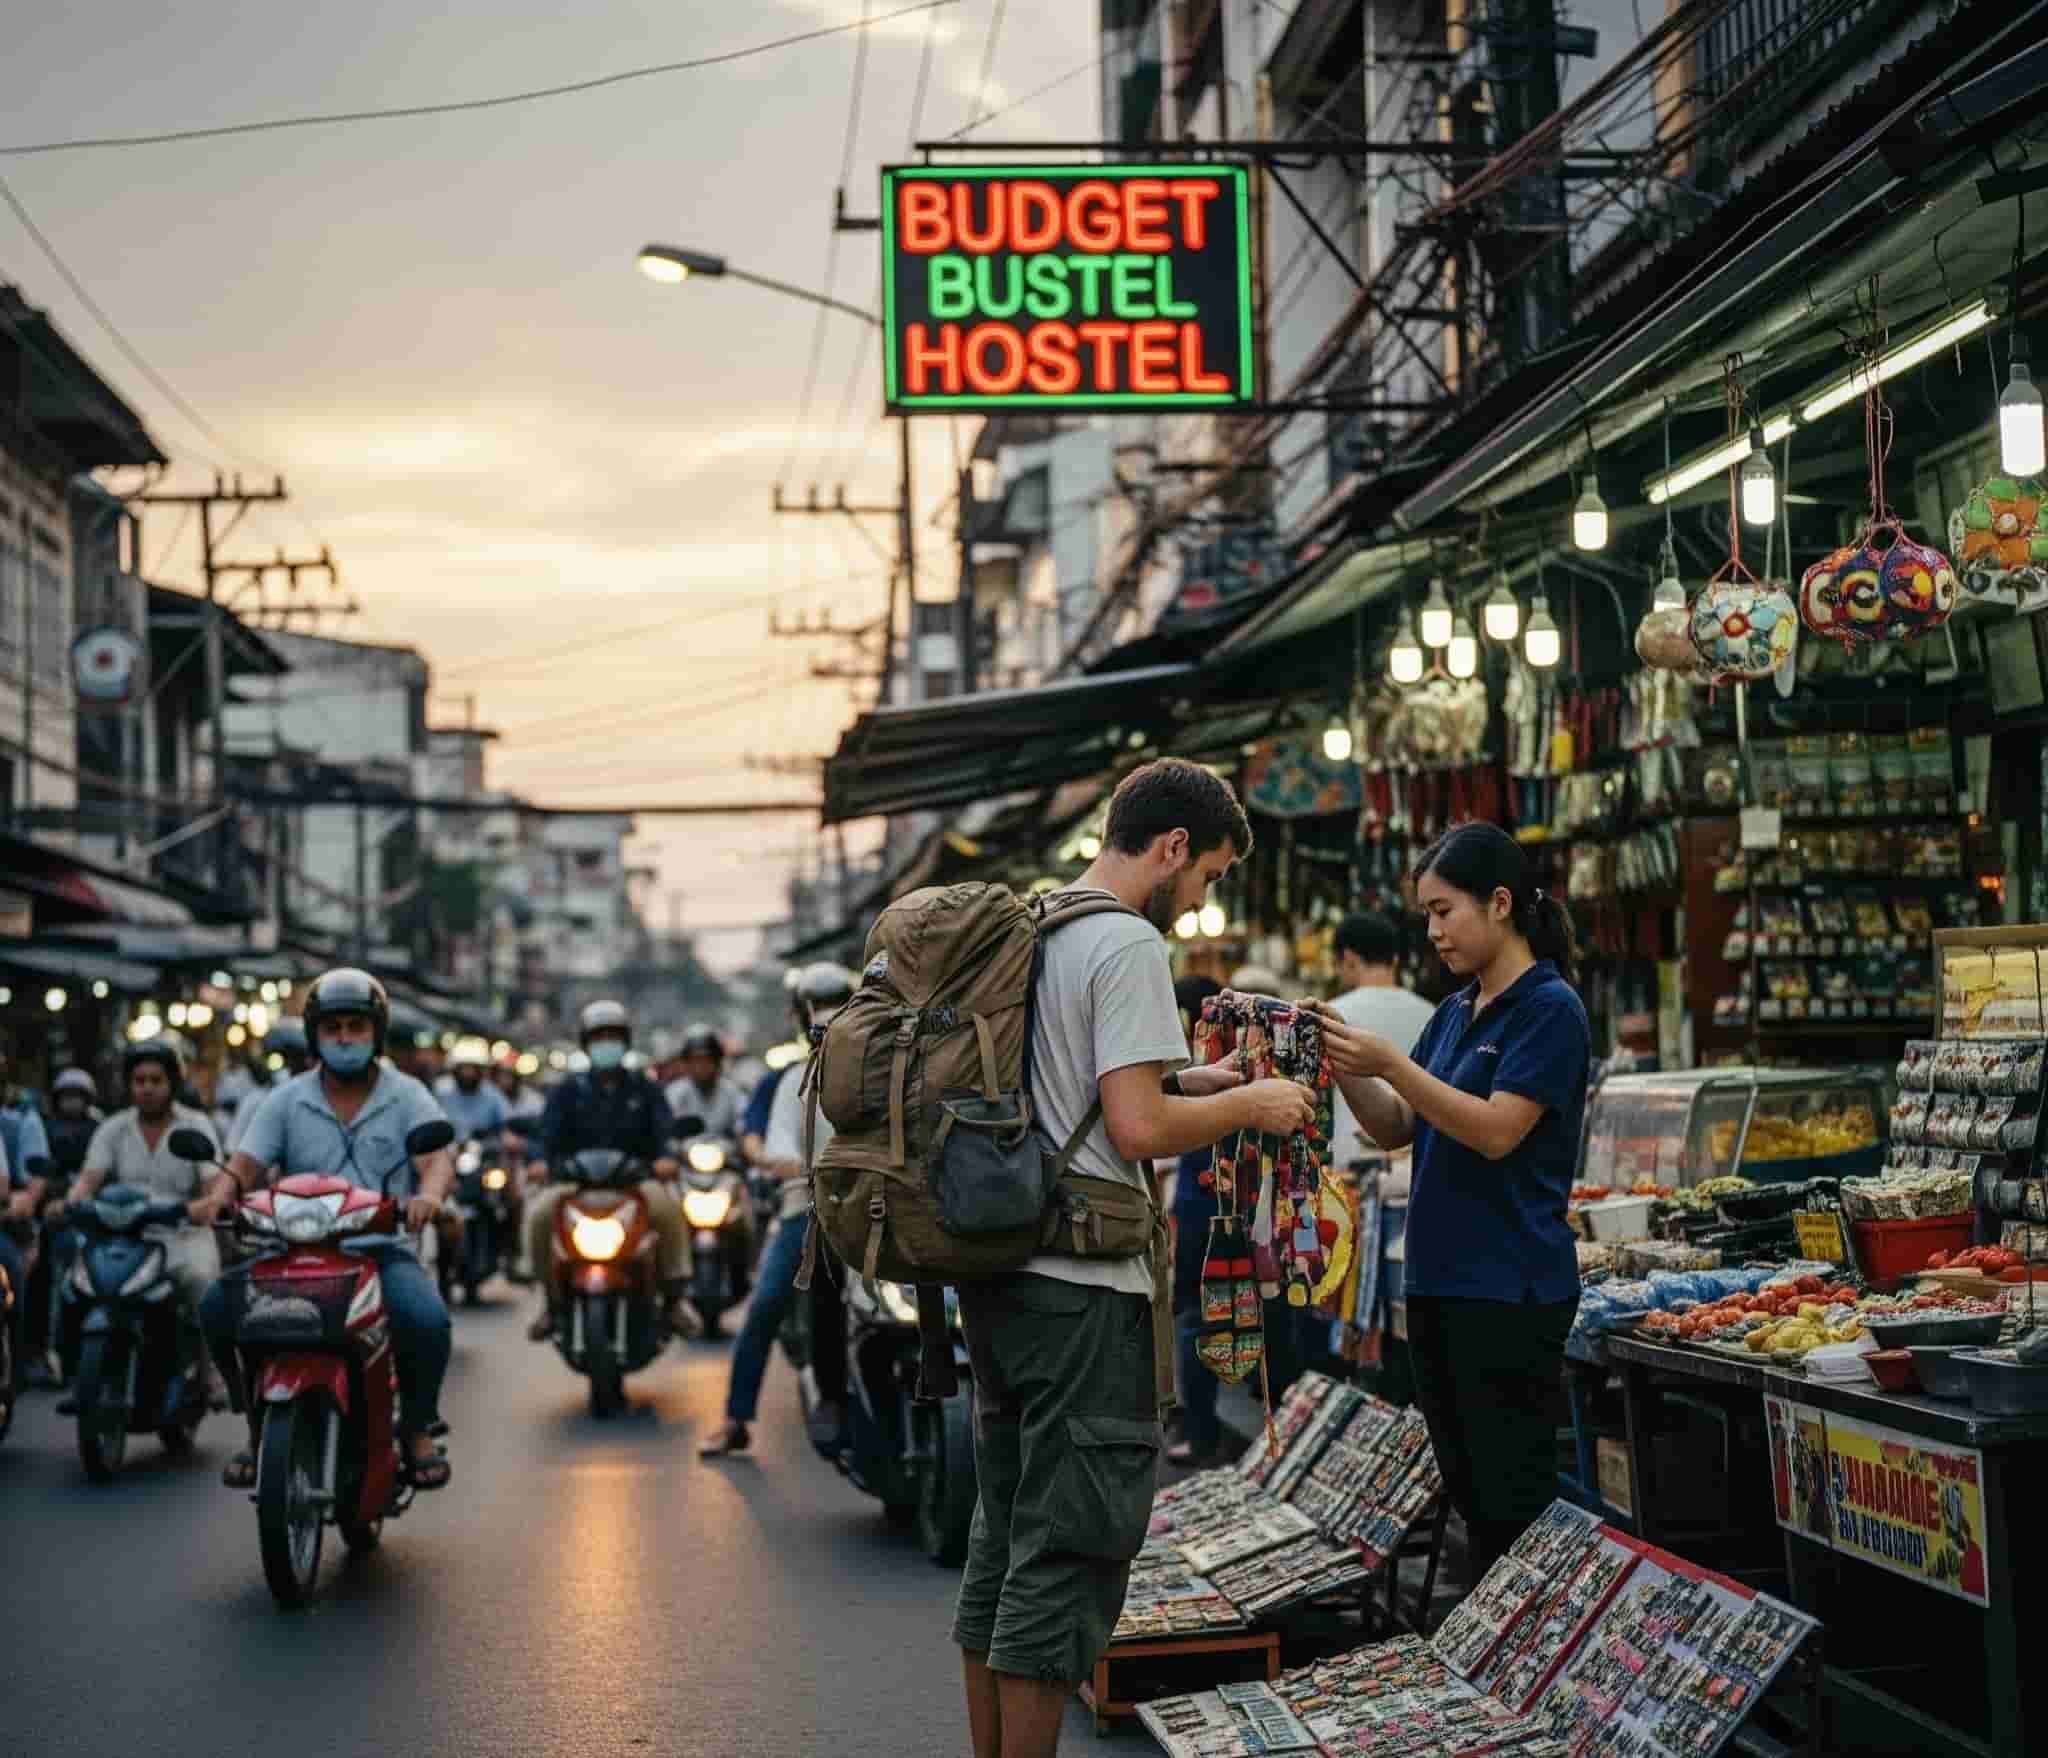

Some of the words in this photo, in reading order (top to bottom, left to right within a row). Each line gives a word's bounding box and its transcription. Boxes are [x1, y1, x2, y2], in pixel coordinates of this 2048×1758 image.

[901, 180, 1218, 252] BUDGET
[928, 255, 1196, 318] BUSTEL
[907, 322, 1228, 392] HOSTEL
